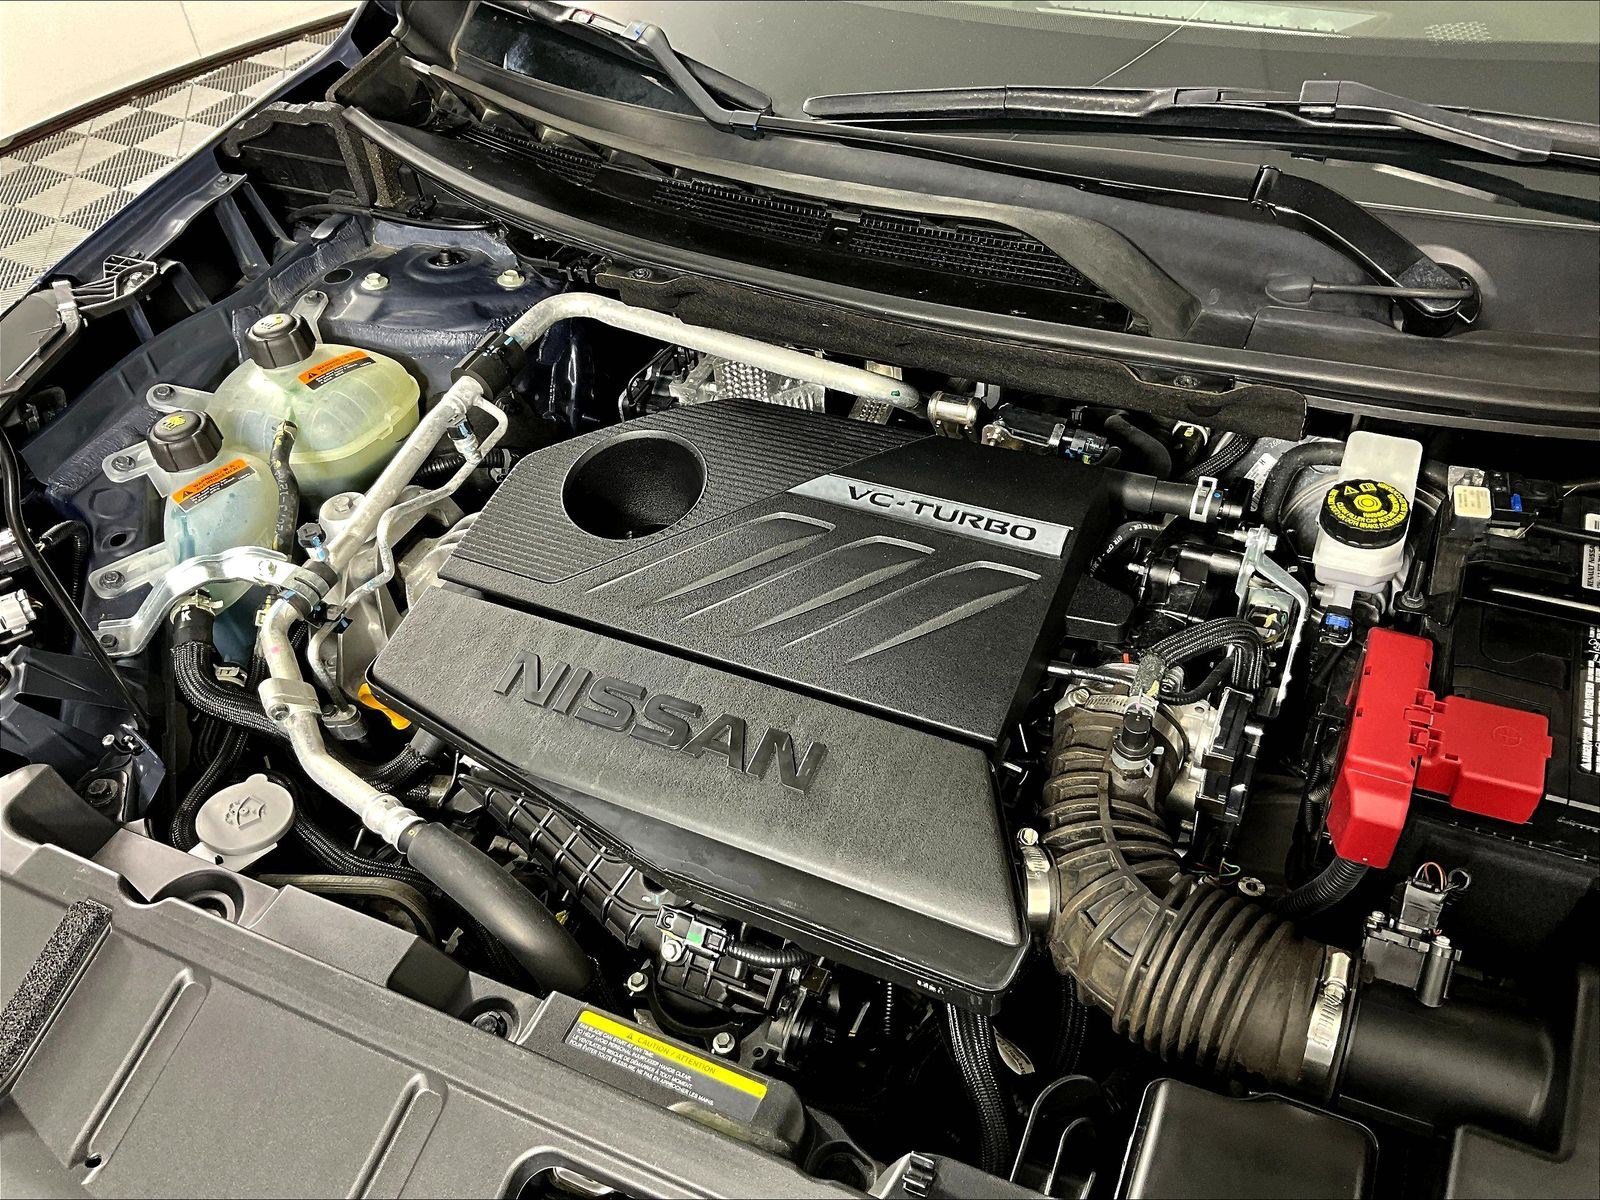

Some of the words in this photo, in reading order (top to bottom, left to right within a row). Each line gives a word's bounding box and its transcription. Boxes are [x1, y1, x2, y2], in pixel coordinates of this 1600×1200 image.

[846, 486, 1038, 542] VC-TURBO
[180, 610, 192, 622] K
[494, 650, 828, 794] NISSAN
[661, 911, 674, 928] C
[569, 1039, 583, 1049] POUR
[643, 1070, 653, 1079] PAS
[578, 1036, 607, 1052] VENTILATEUR
[606, 1048, 624, 1060] RISQUE
[659, 1070, 672, 1080] TOUT
[637, 1037, 669, 1055] CAUTION
[675, 1053, 716, 1075] ATTENTION
